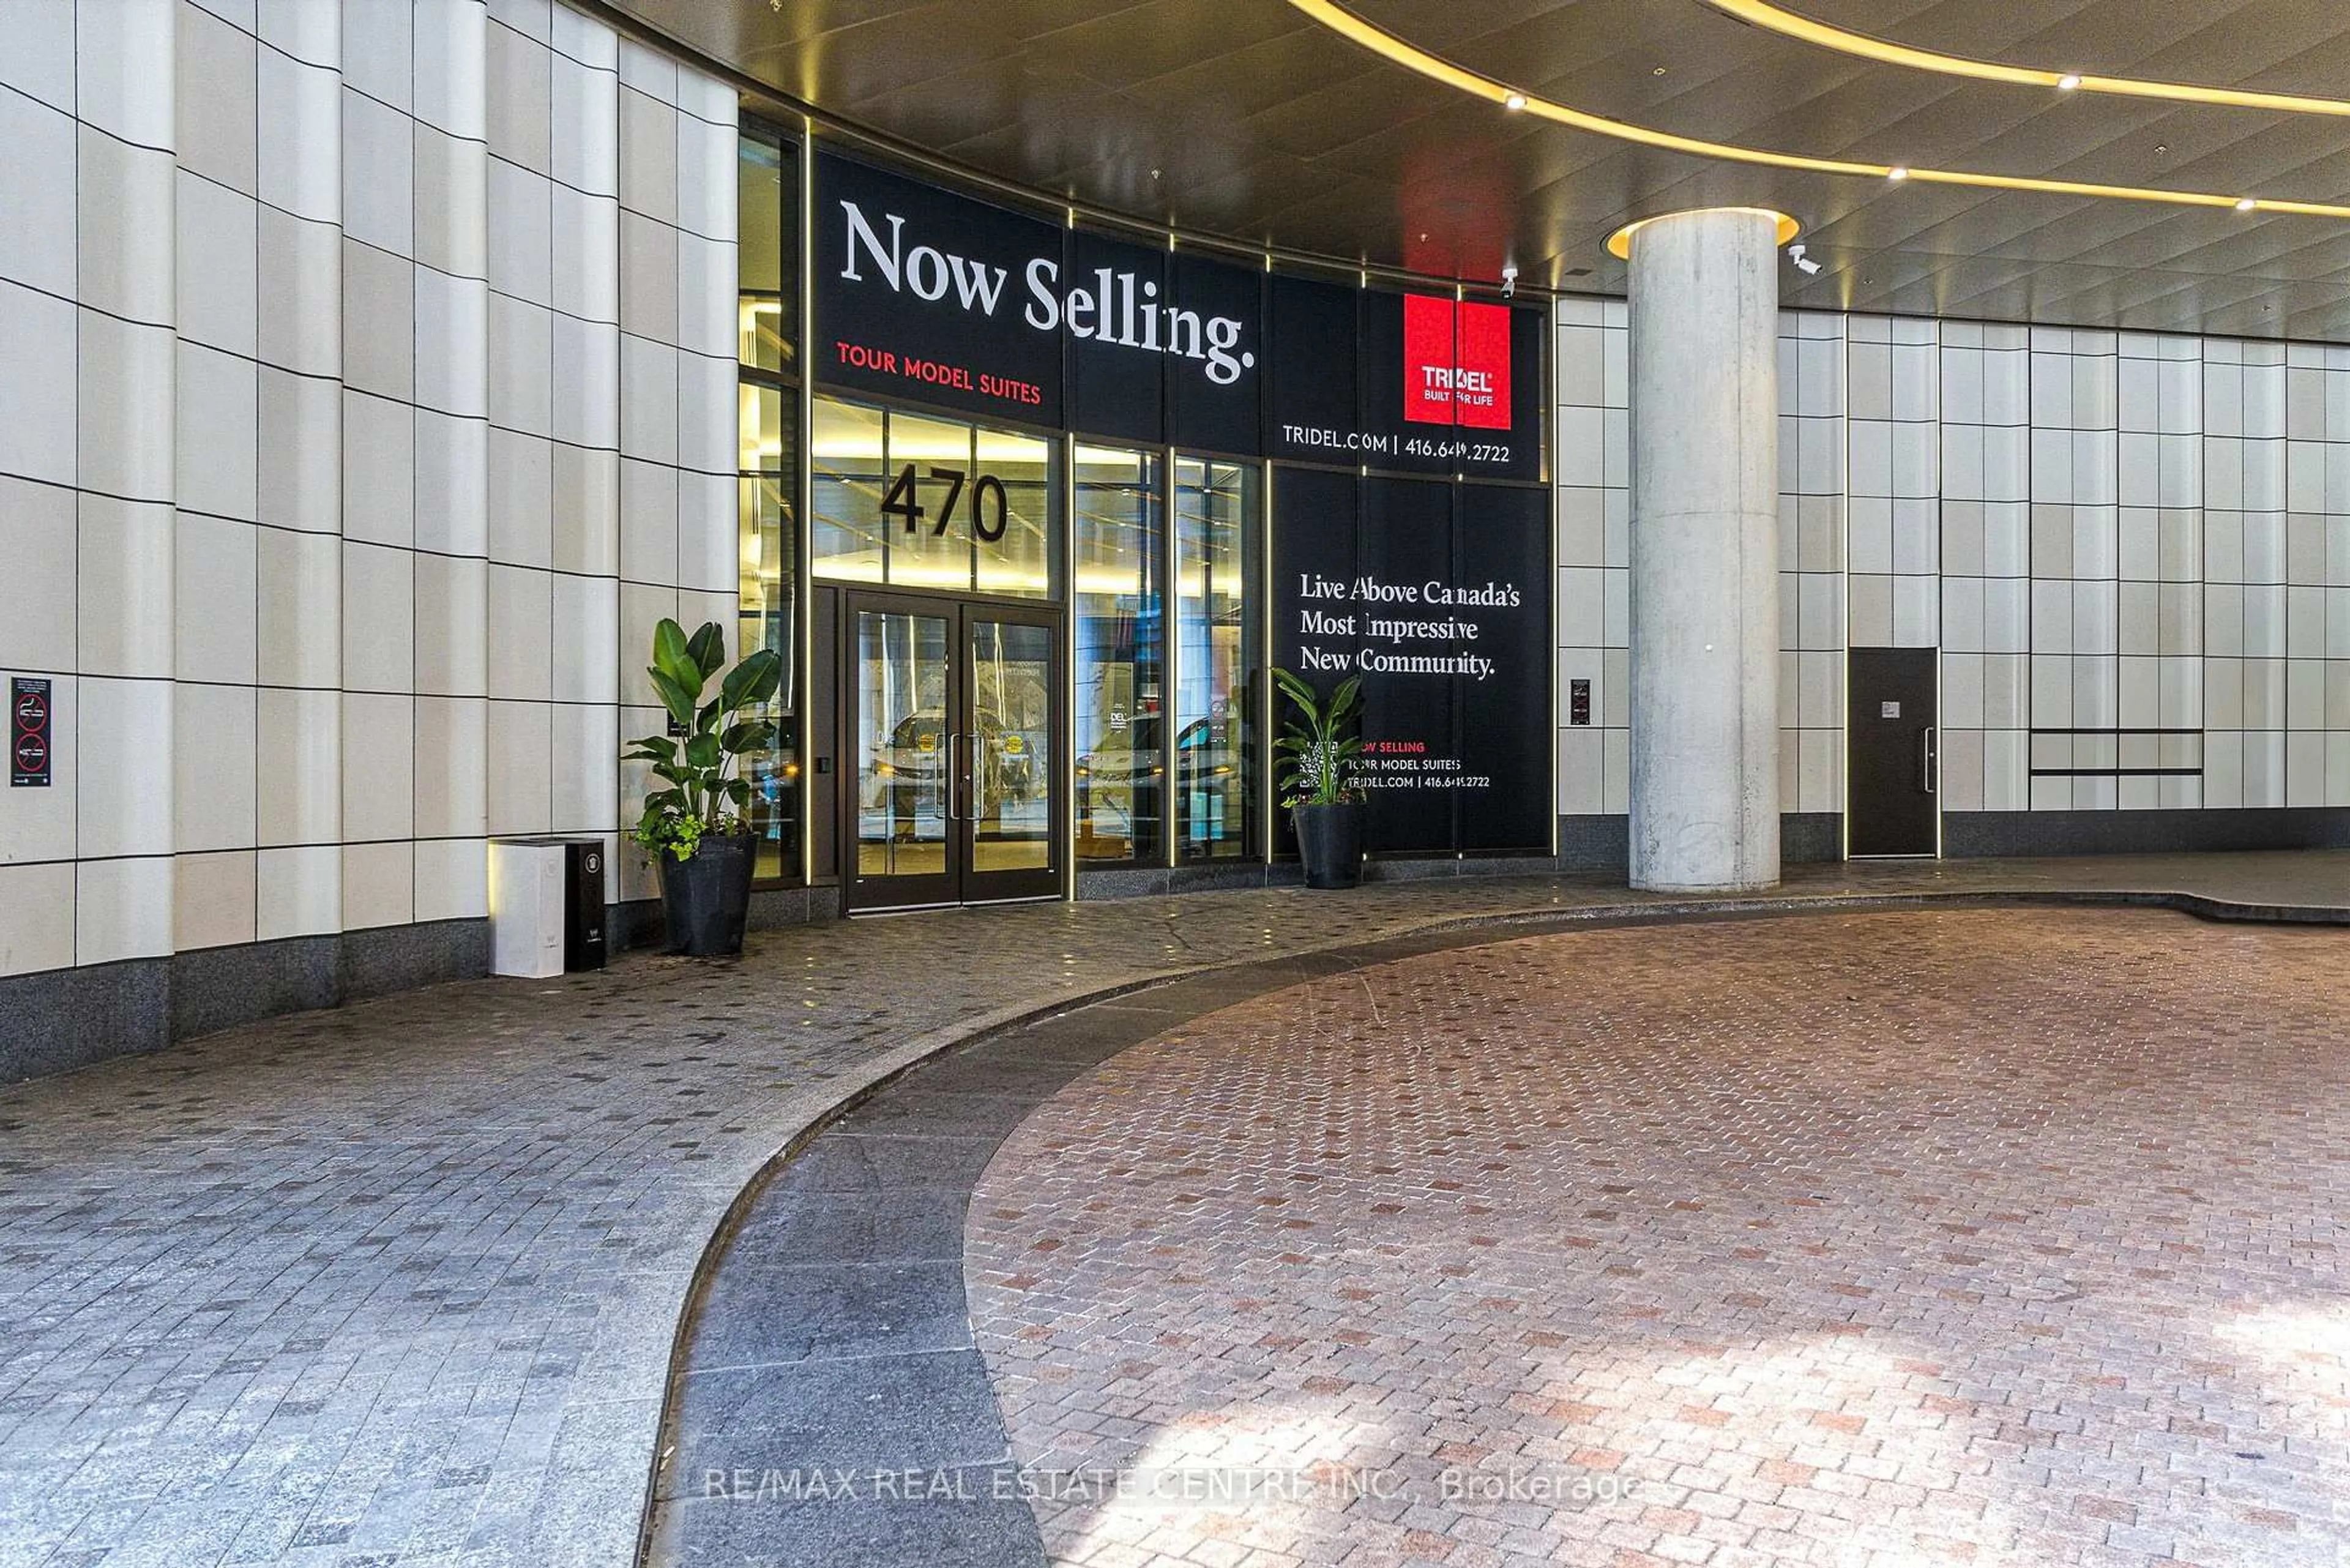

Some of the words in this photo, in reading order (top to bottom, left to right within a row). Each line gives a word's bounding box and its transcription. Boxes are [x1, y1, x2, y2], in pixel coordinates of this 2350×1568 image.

[840, 200, 1007, 316] Now
[1025, 258, 1254, 384] Selling.
[837, 342, 898, 374] TOUR
[904, 357, 974, 390] MODEL
[980, 373, 1040, 404] SUITES
[1424, 390, 1450, 401] BUILT
[1473, 395, 1493, 406] LIFE
[1283, 425, 1387, 452] TRIDEL.COM
[1406, 438, 1510, 462] 416.649.2722
[881, 463, 1007, 542] 470
[1300, 574, 1345, 600] Live
[1349, 577, 1418, 603] Above
[1423, 581, 1521, 607] Canada's
[1300, 610, 1356, 635] Most
[1365, 613, 1479, 643] Impressive
[1300, 646, 1351, 670] New
[1356, 648, 1495, 681] Community.
[1379, 742, 1425, 753] SELLING
[1381, 760, 1419, 770] MODEL
[1422, 760, 1461, 770] SUITES
